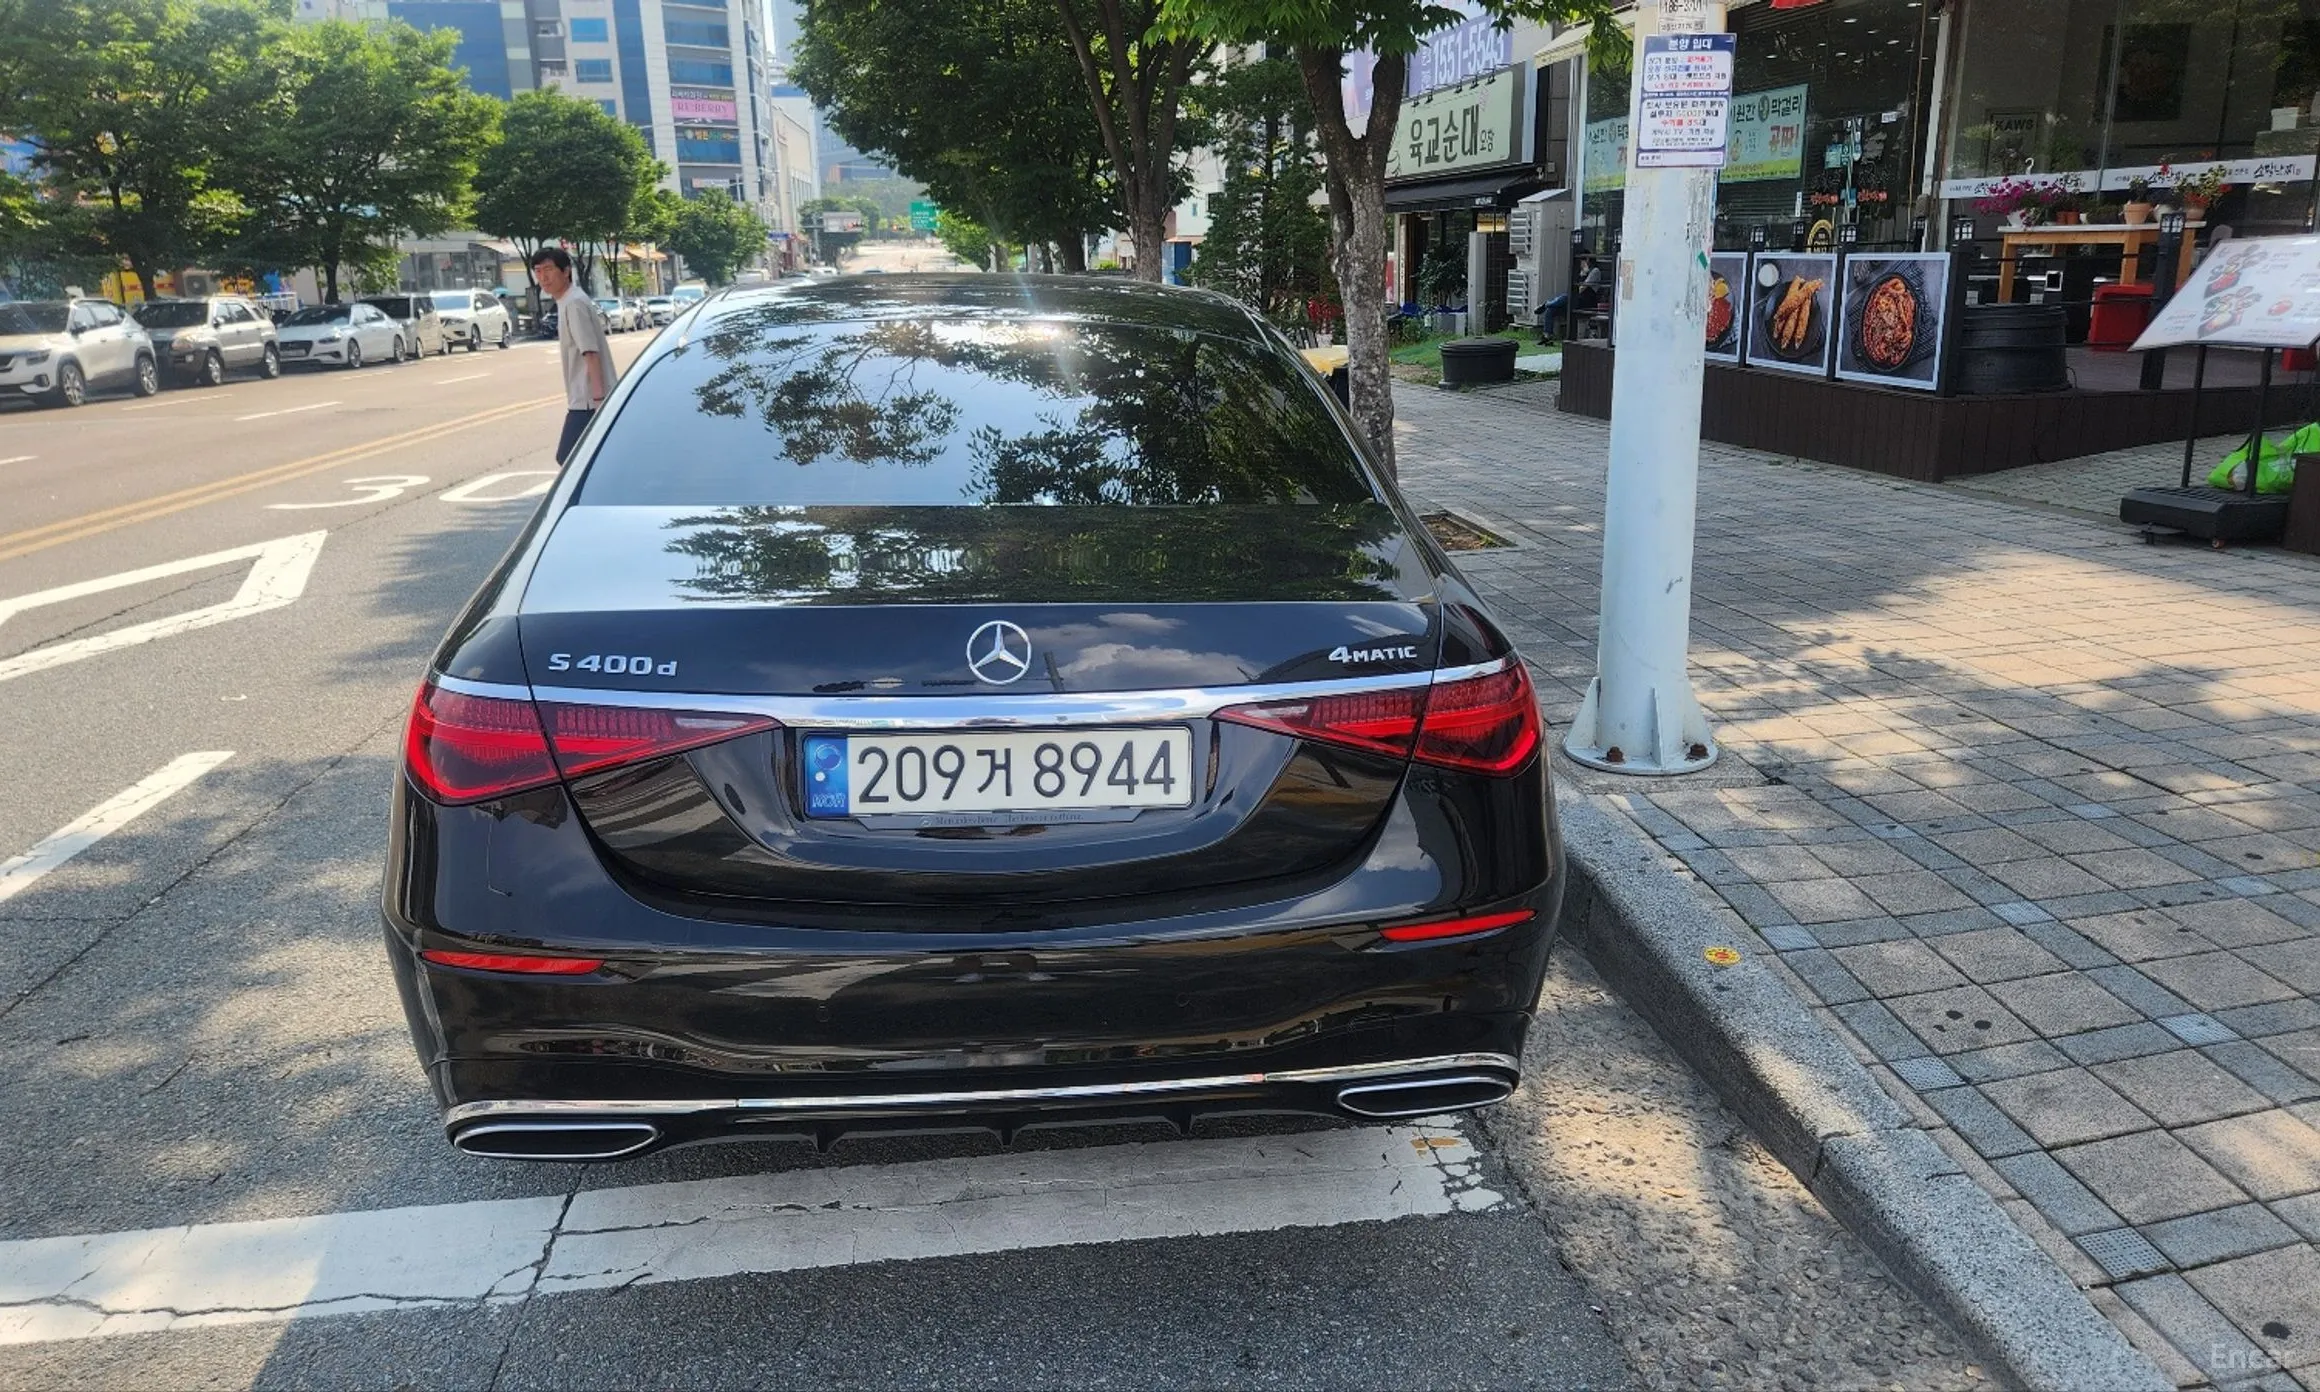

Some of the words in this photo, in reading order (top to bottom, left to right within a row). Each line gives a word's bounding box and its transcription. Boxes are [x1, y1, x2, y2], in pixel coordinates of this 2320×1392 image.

[1668, 38, 1690, 51] 분양
[1692, 38, 1713, 50] 임대
[1770, 93, 1803, 117] 막걸리
[1994, 118, 2034, 131] KAWS
[1408, 104, 1480, 168] 육교순대
[1328, 645, 1418, 663] 4MATIC
[857, 744, 1013, 803] 209거
[1033, 740, 1176, 799] 8944
